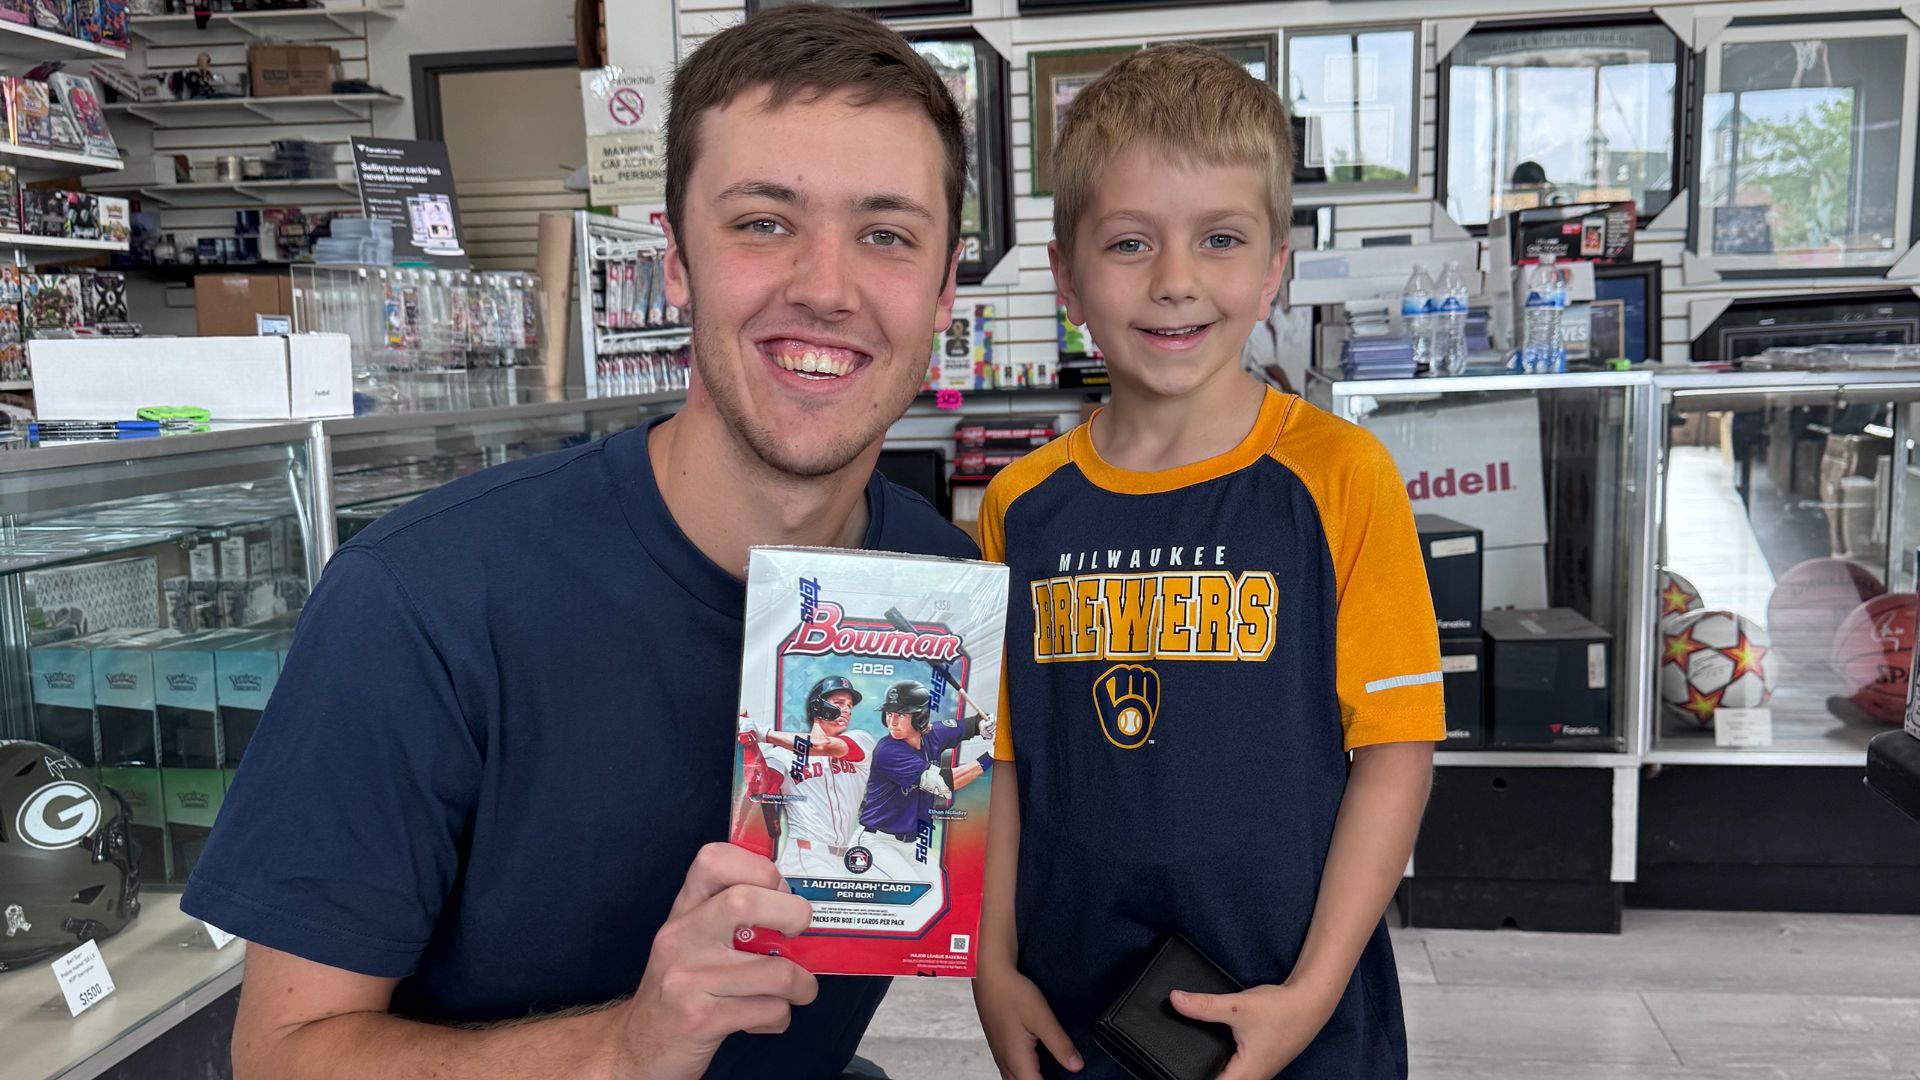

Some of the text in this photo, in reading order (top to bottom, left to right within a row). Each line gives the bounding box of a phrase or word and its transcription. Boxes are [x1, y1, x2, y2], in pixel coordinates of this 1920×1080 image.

[360, 161, 441, 176] Selling your cards has
[362, 173, 428, 184] never been easier
[1058, 545, 1226, 572] MILWAUKEE
[1030, 570, 1279, 664] BREWERS
[782, 600, 963, 662] Bowman
[852, 663, 895, 676] 2026
[1563, 724, 1599, 735] Fanatics
[916, 818, 936, 865] topps
[802, 880, 809, 888] 1
[881, 884, 911, 892] CARD
[830, 916, 841, 924] PER
[842, 916, 853, 924] BOX
[80, 983, 102, 1006] $1500
